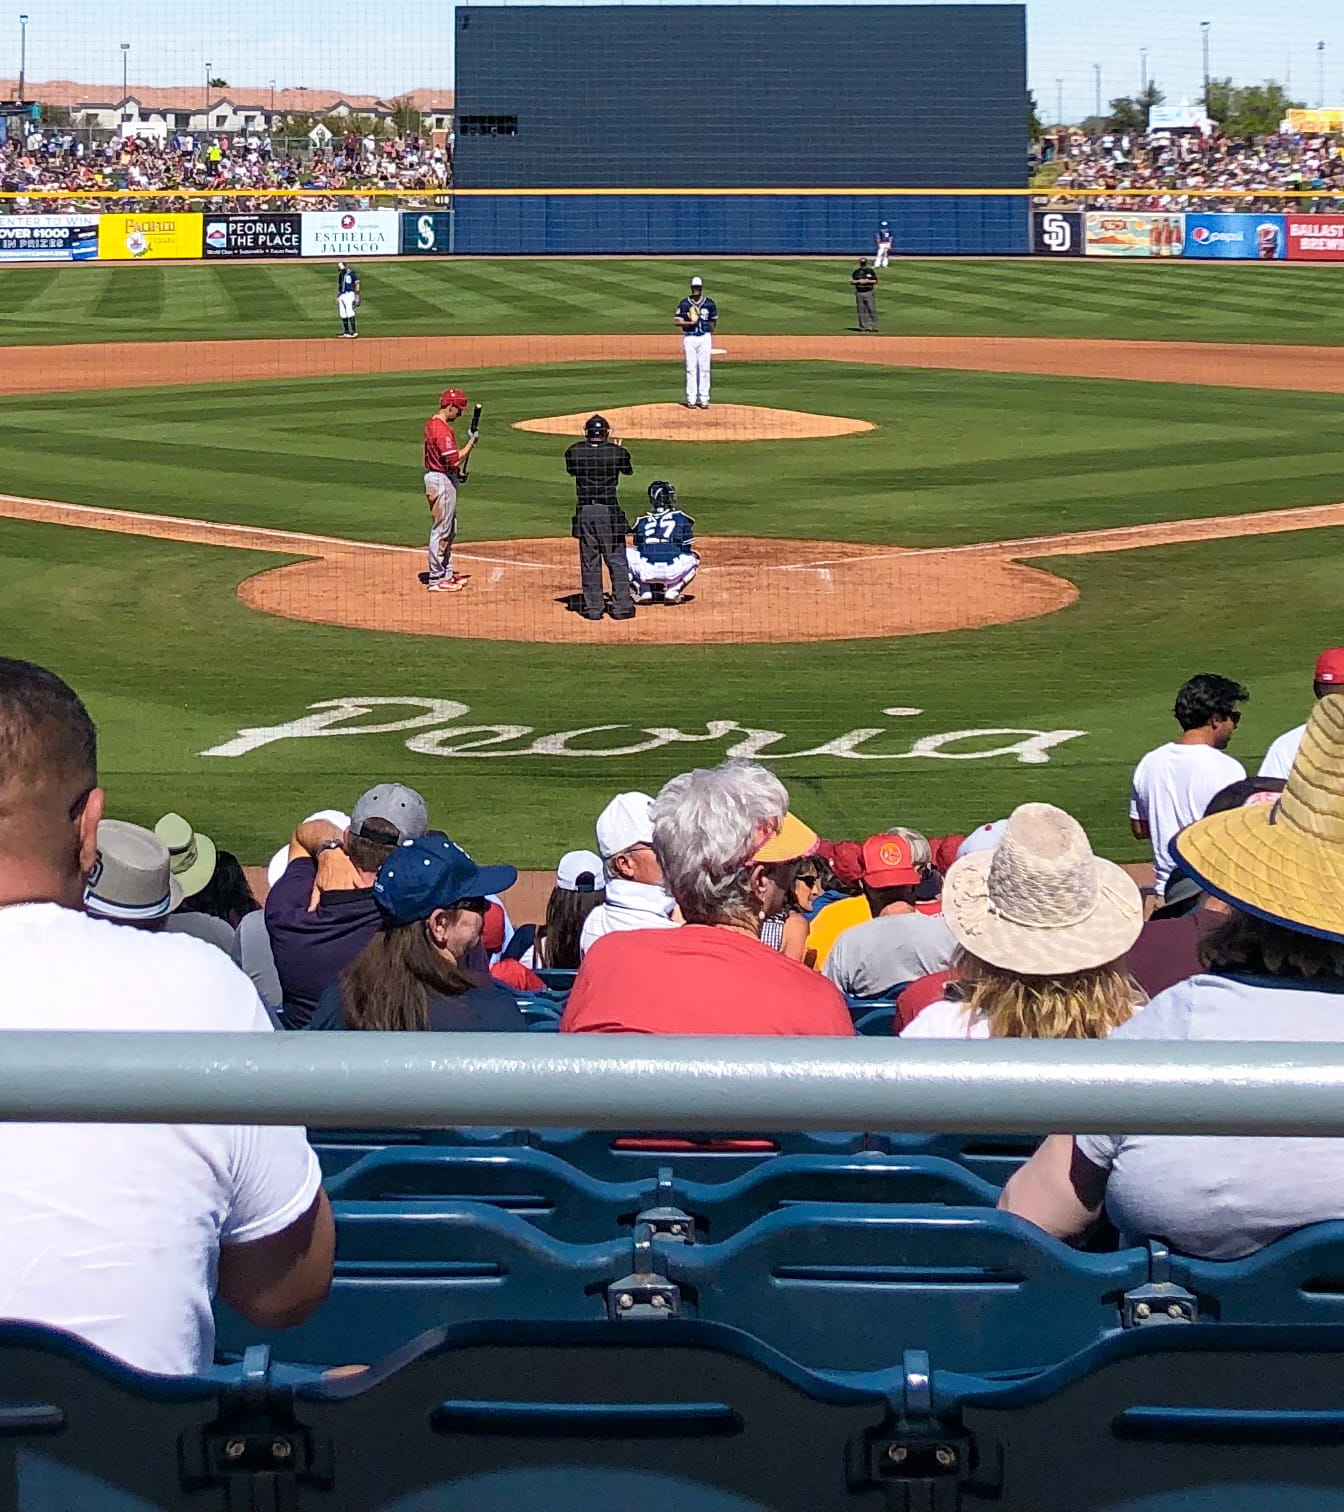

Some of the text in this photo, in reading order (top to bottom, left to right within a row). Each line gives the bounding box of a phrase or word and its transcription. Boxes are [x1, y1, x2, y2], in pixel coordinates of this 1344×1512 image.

[0, 217, 92, 226] ENTER TO WIN
[33, 228, 70, 239] $1000
[229, 223, 292, 234] PEORIA IS
[1289, 224, 1344, 237] BALLAST
[230, 234, 299, 246] THE PLACE
[315, 232, 385, 242] ESTRELLA
[1209, 231, 1244, 245] pepsi
[3, 239, 64, 248] IN PRIZES
[320, 243, 379, 253] JALISCO
[197, 695, 1091, 765] Peoria
